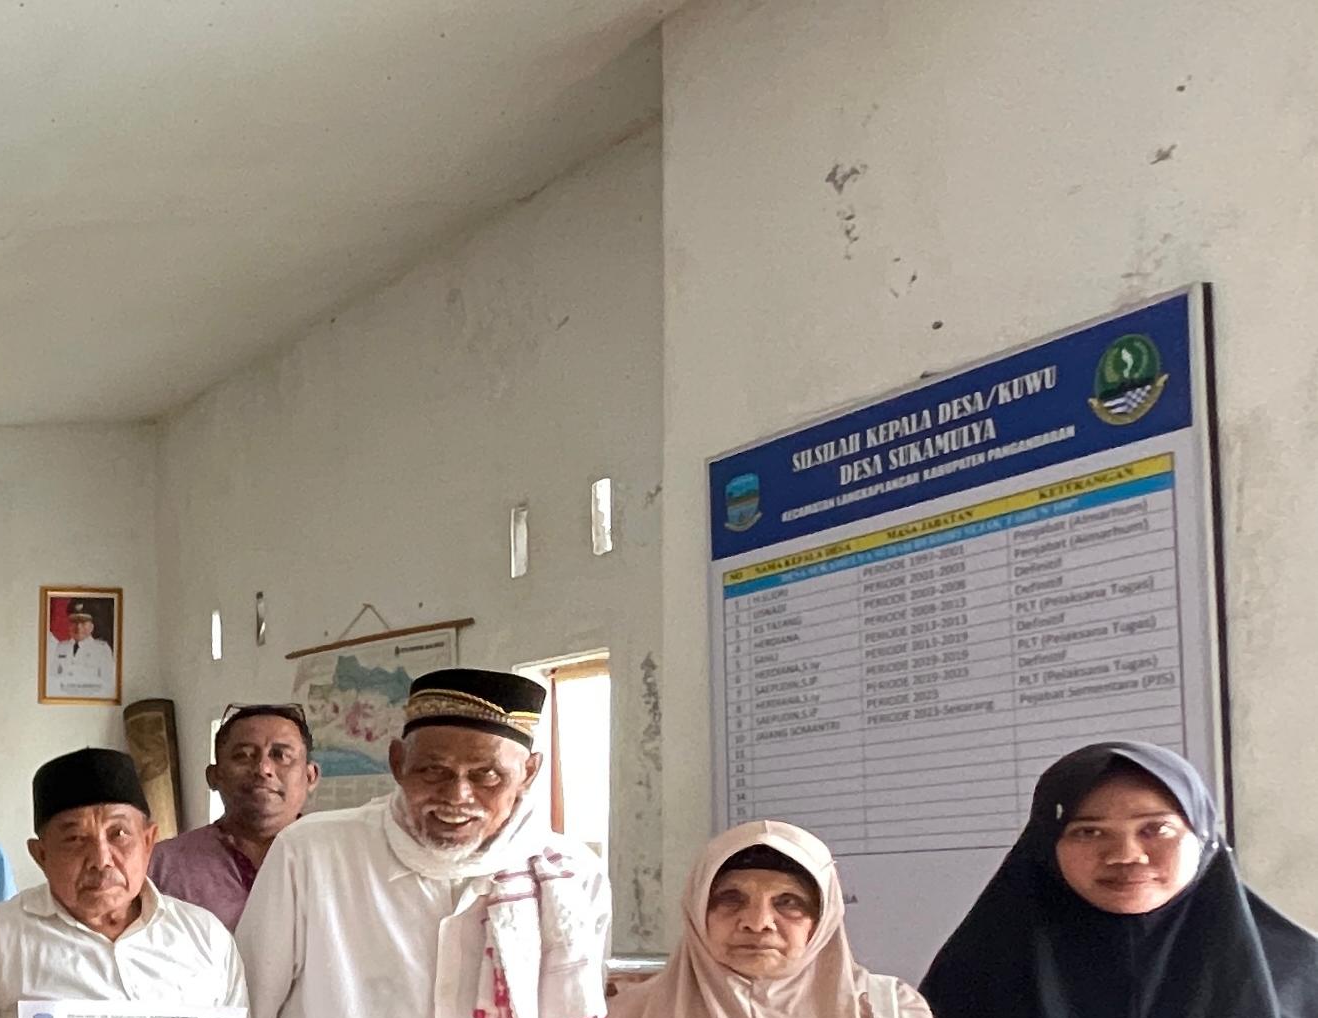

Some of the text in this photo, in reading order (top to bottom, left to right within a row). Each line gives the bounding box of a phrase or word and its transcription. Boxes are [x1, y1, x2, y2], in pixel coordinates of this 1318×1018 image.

[792, 365, 1057, 473] SILSILAH KEPALA DESA/KUWU
[839, 418, 996, 486] DESA SUKAMULYA
